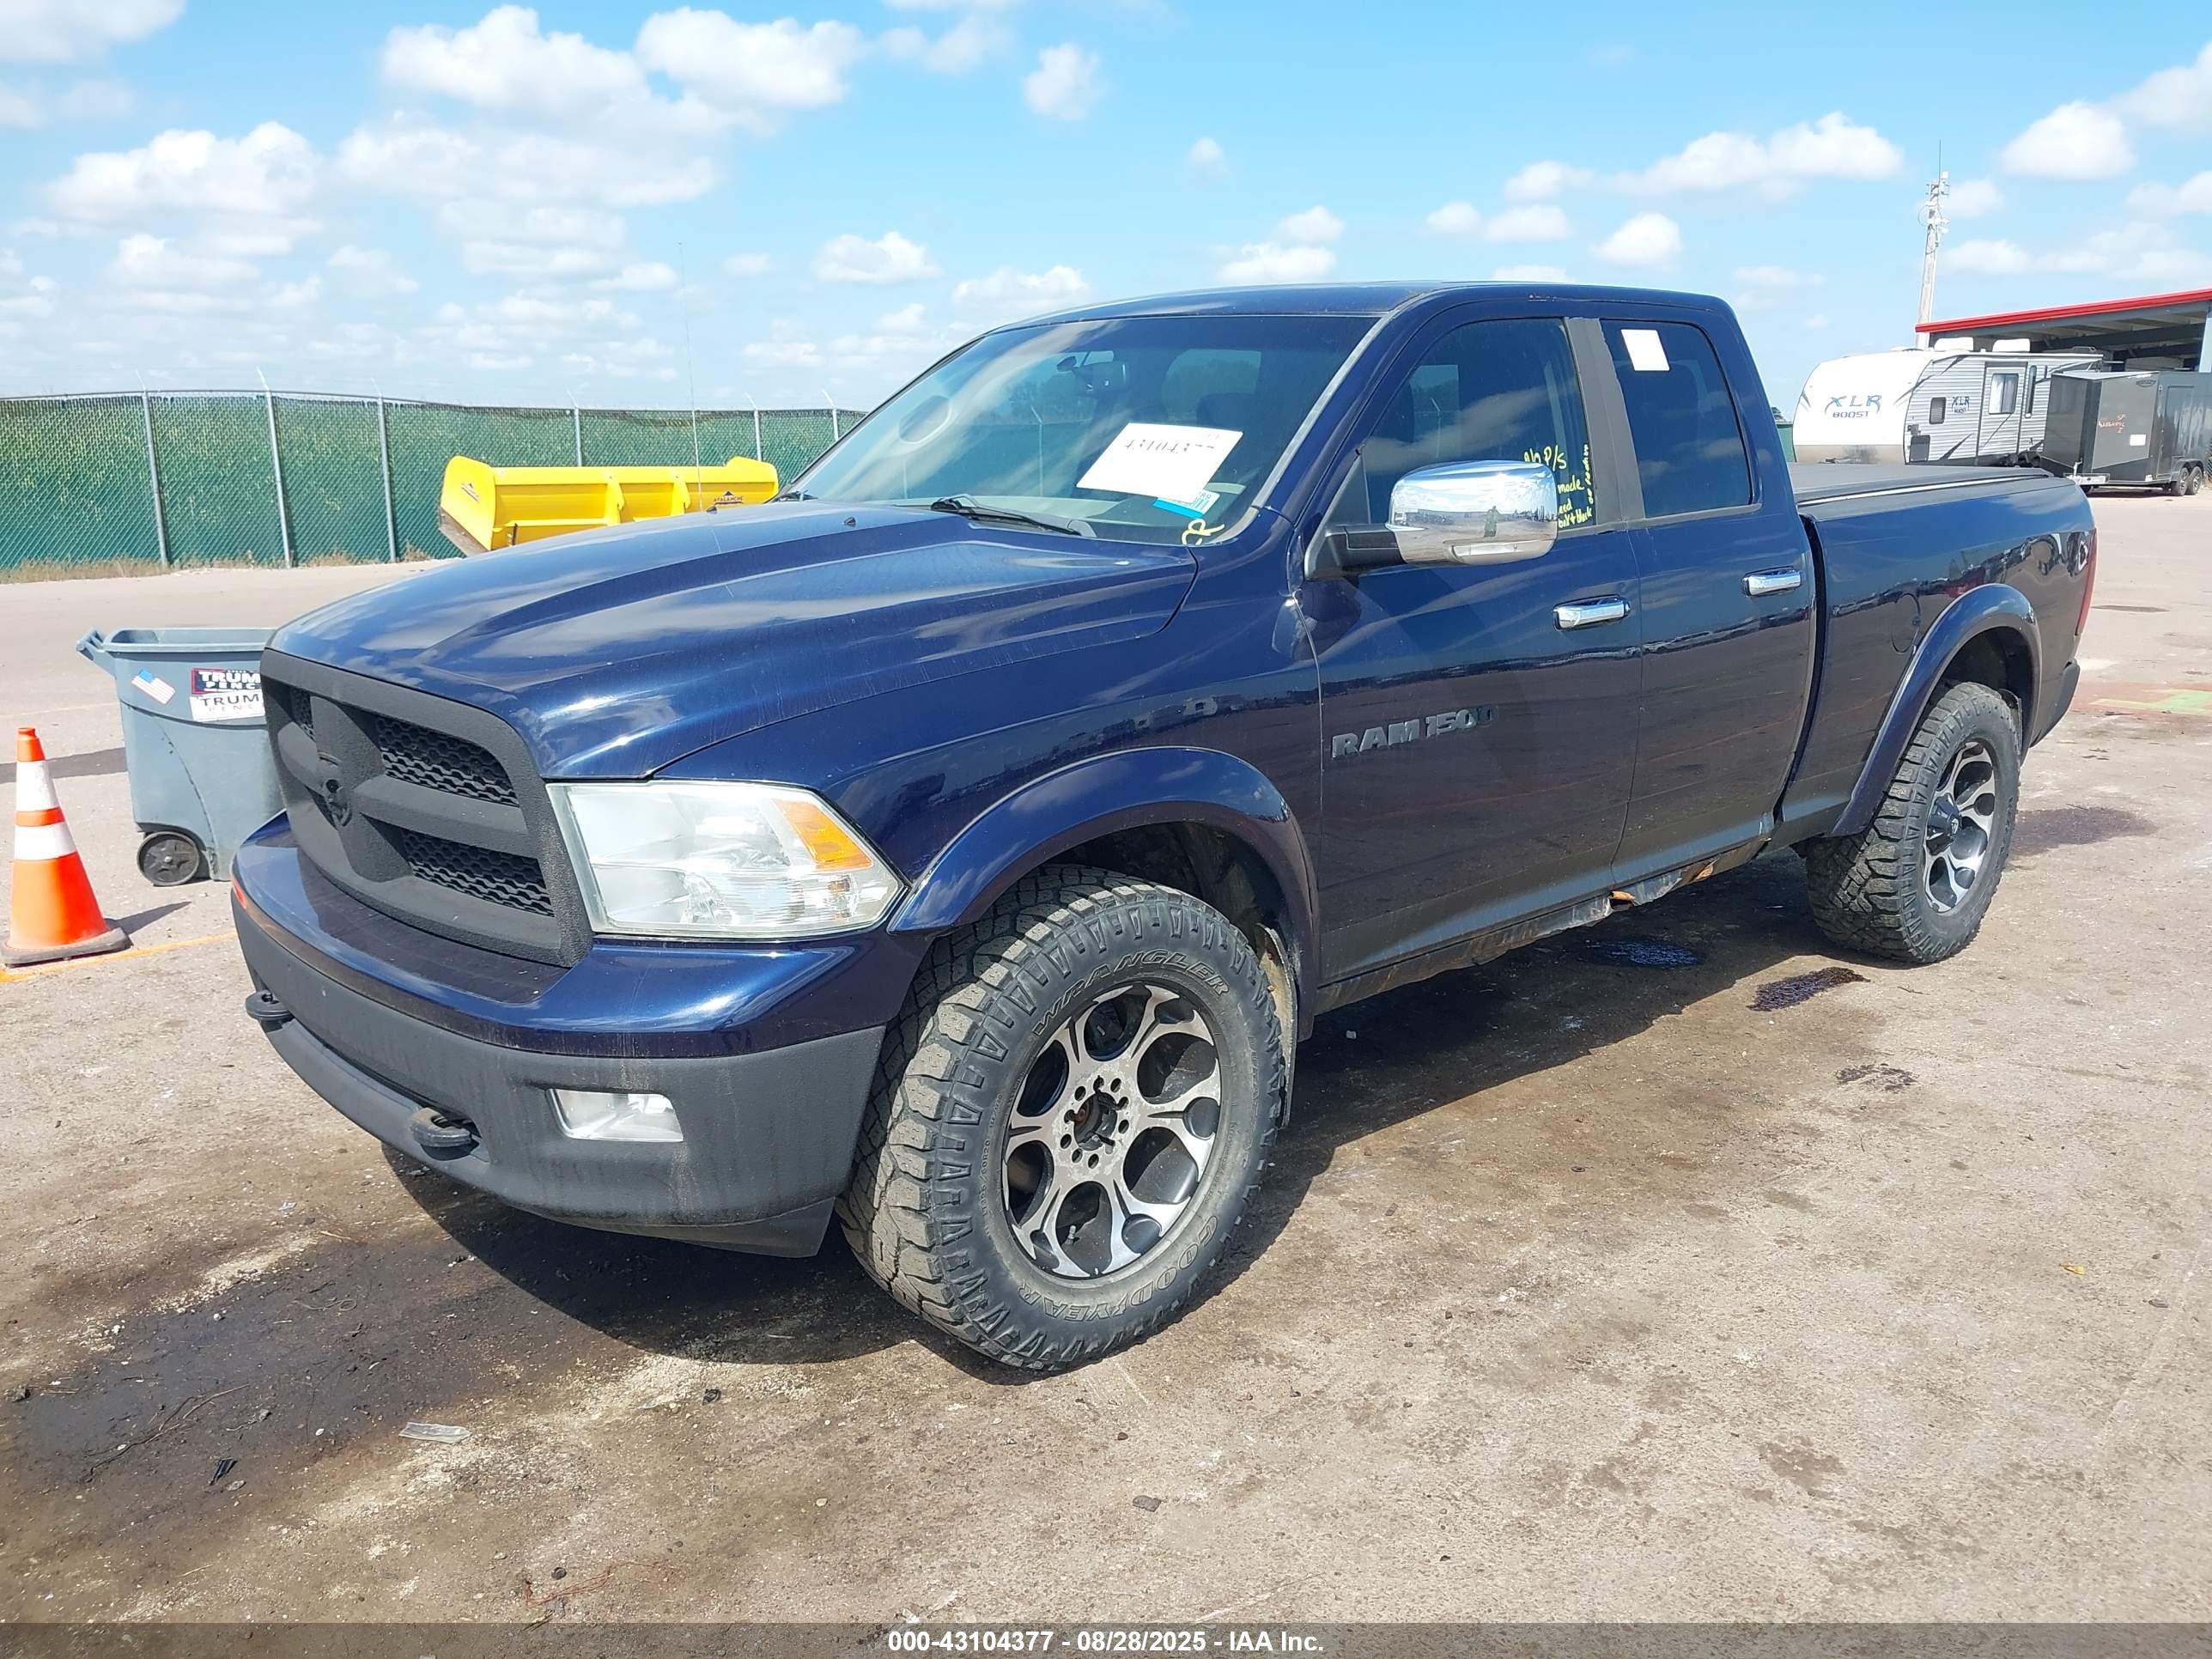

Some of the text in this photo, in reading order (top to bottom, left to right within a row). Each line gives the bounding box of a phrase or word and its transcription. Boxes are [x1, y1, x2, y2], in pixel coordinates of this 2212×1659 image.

[1825, 395, 1882, 413] XLR
[1123, 439, 1214, 453] 4104
[198, 671, 261, 684] TRUM
[205, 681, 260, 690] PENC
[199, 693, 259, 707] TRUM
[1332, 706, 1493, 757] RAM 1500
[1032, 949, 1230, 1036] WRANGLER
[1018, 1216, 1218, 1322] GOODYEAR
